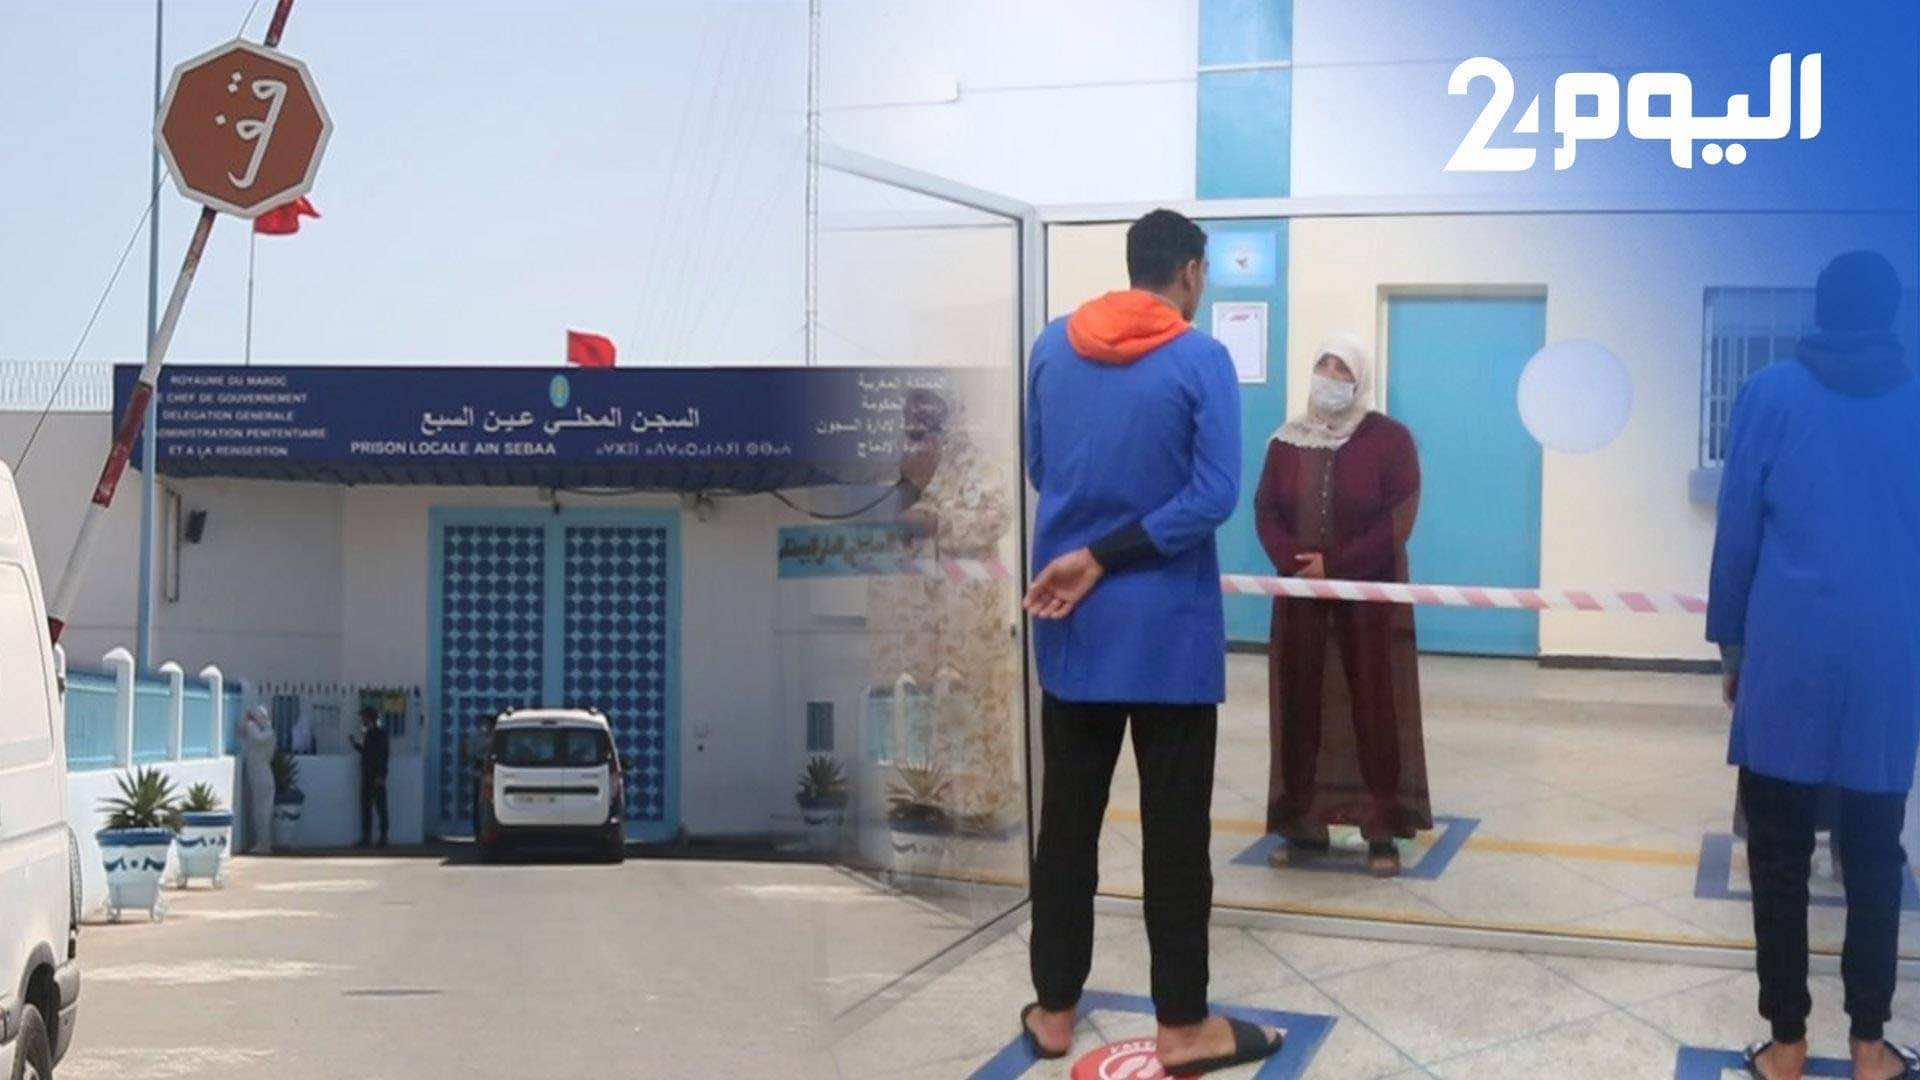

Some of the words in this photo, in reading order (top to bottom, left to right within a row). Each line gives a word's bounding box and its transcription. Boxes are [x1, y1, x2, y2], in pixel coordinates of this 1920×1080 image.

[213, 72, 287, 188] قف
[171, 375, 224, 386] ROYAUME
[227, 375, 244, 386] DU
[246, 375, 287, 386] MAROC
[166, 393, 194, 403] CHEF
[198, 393, 214, 403] DE
[217, 393, 308, 404] GOUVERNEMENT
[420, 405, 475, 436] السبع
[483, 411, 534, 432] عين
[631, 406, 699, 433] السجن
[168, 446, 182, 456] ET
[215, 446, 288, 457] REINSERTION
[351, 440, 406, 456] PRISON
[408, 440, 470, 456] LOCALE
[474, 440, 500, 456] AIN
[504, 440, 557, 456] SEBAA
